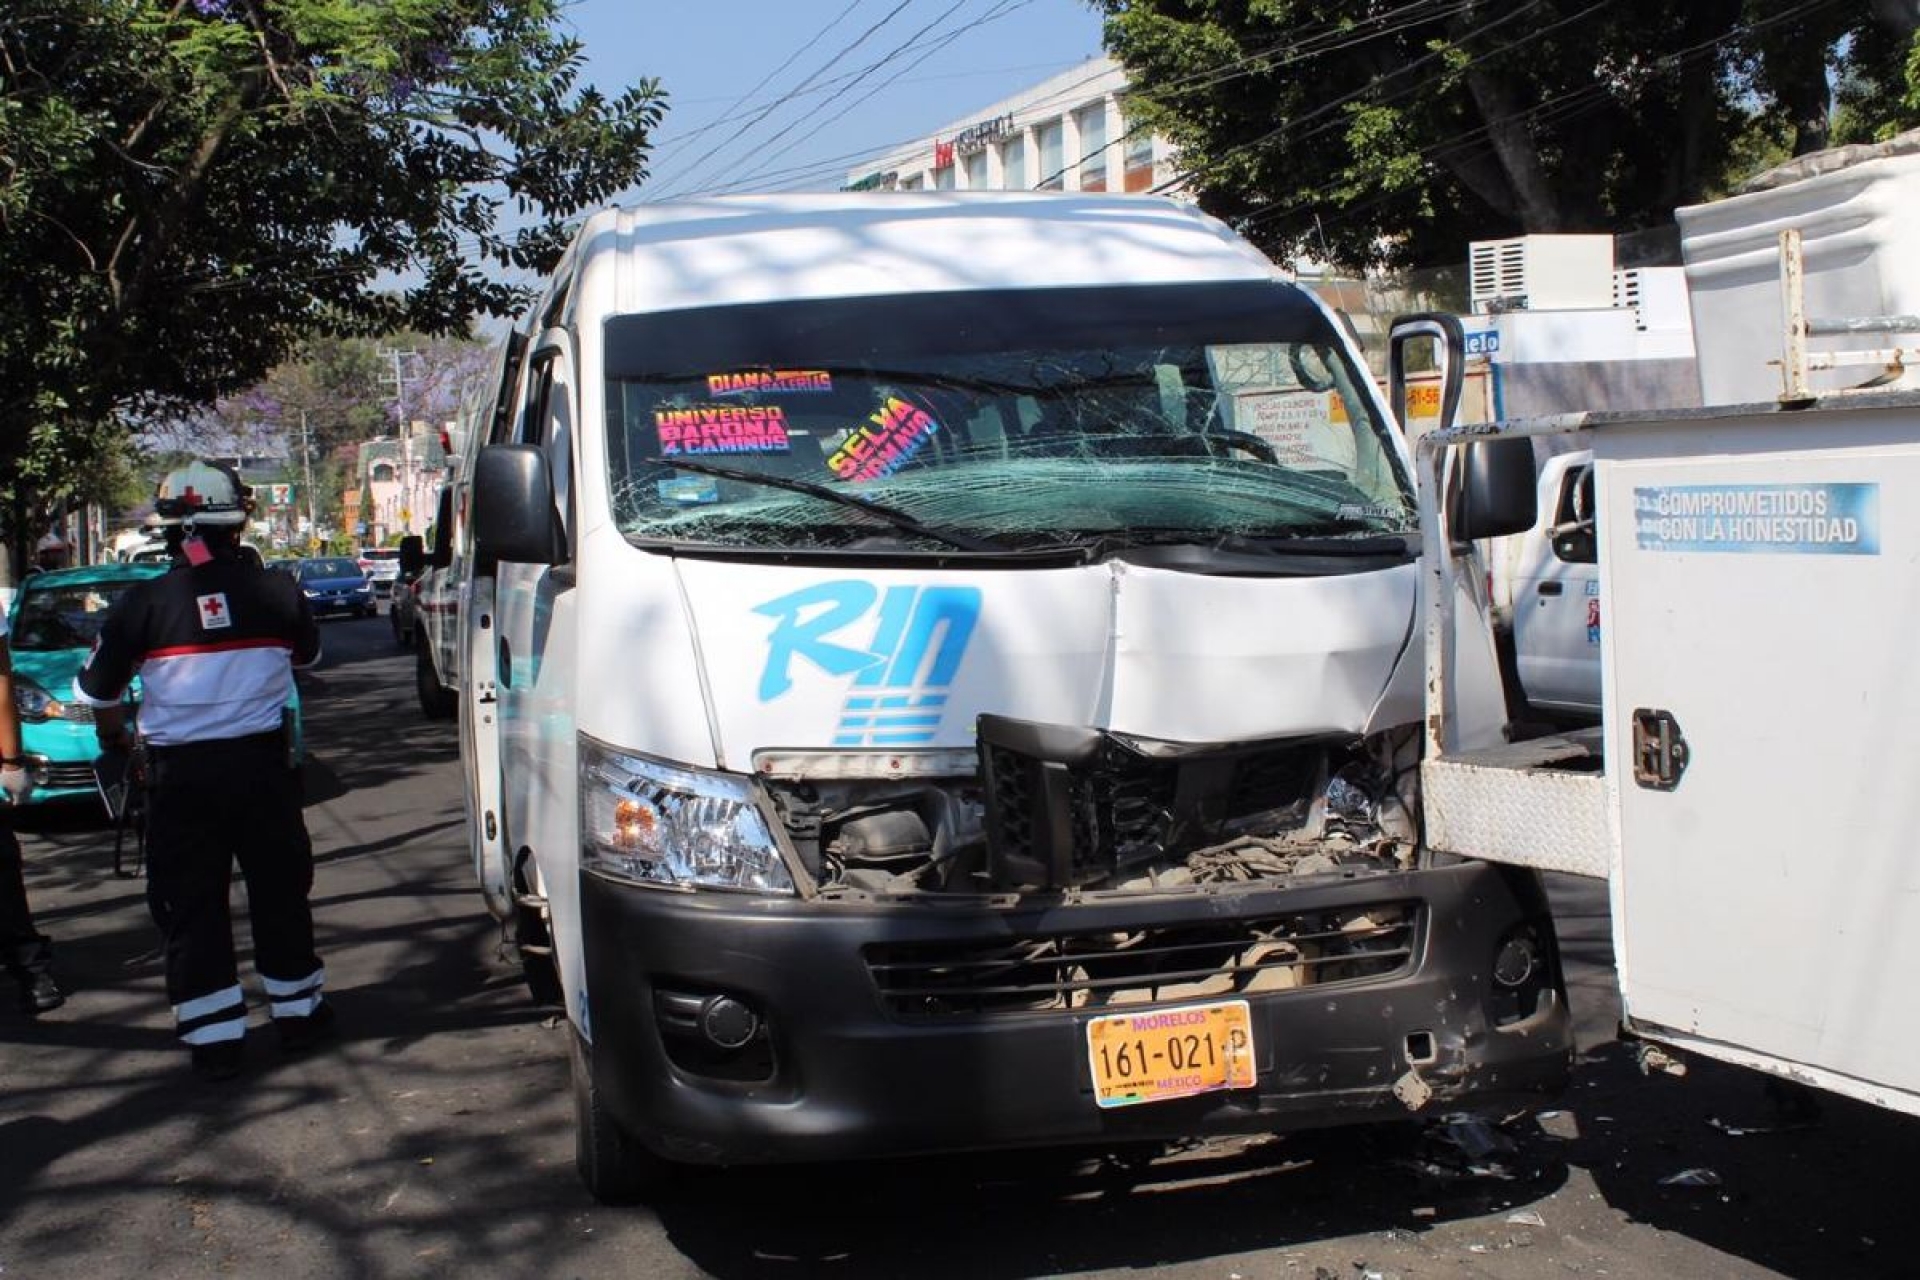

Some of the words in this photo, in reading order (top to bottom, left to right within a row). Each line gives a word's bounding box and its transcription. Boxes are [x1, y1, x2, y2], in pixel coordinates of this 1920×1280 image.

[708, 373, 771, 393] DIANA
[656, 406, 783, 426] UNIVERSO
[659, 420, 785, 440] BARONA
[828, 397, 914, 479] SELVA
[684, 435, 789, 454] CAMINOS
[1659, 490, 1828, 516] COMPROMETIDOS
[1660, 518, 1698, 541] CON
[1703, 518, 1726, 541] LA
[1730, 518, 1858, 543] HONESTIDAD
[1132, 1011, 1206, 1032] MORELOS
[1101, 1032, 1215, 1079] 161-021
